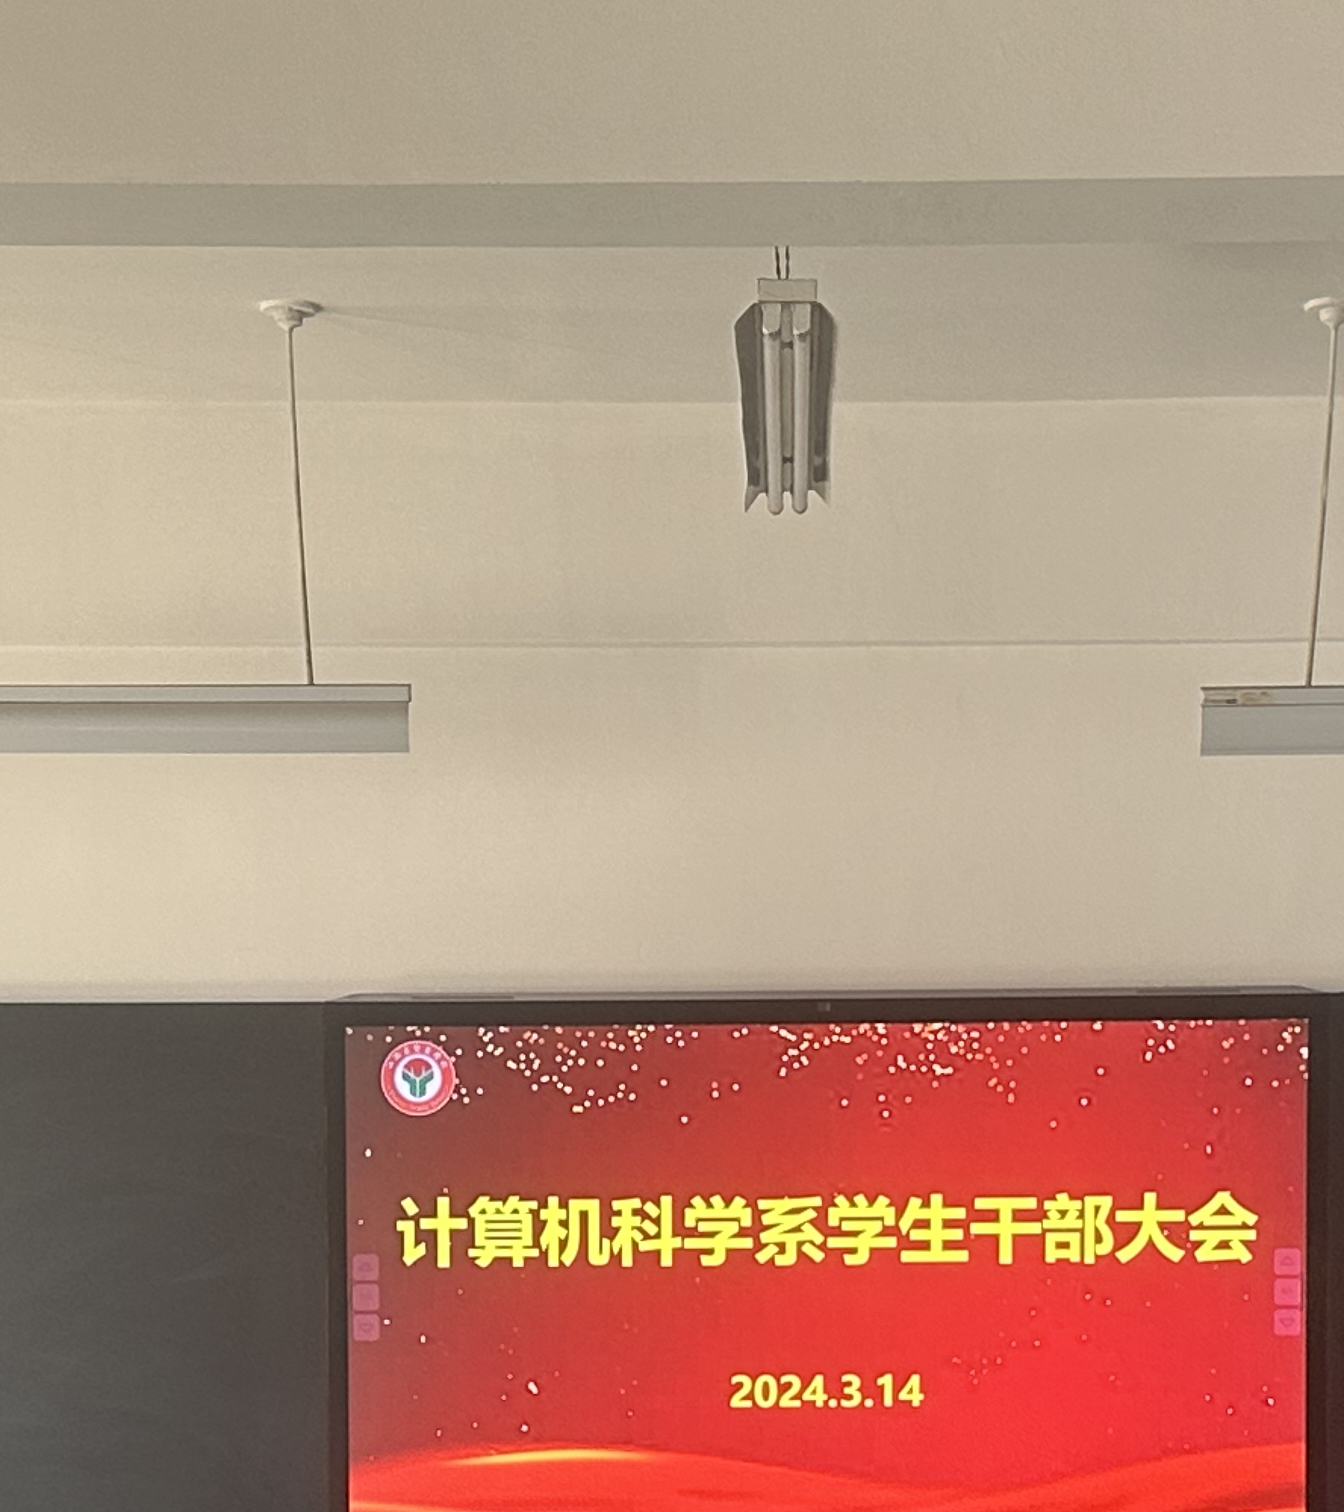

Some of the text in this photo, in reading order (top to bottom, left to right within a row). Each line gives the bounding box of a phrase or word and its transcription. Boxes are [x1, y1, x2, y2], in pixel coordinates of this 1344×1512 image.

[397, 1190, 1258, 1267] 计算机科学系学生干部大会
[730, 1373, 924, 1408] 2024.3.14
